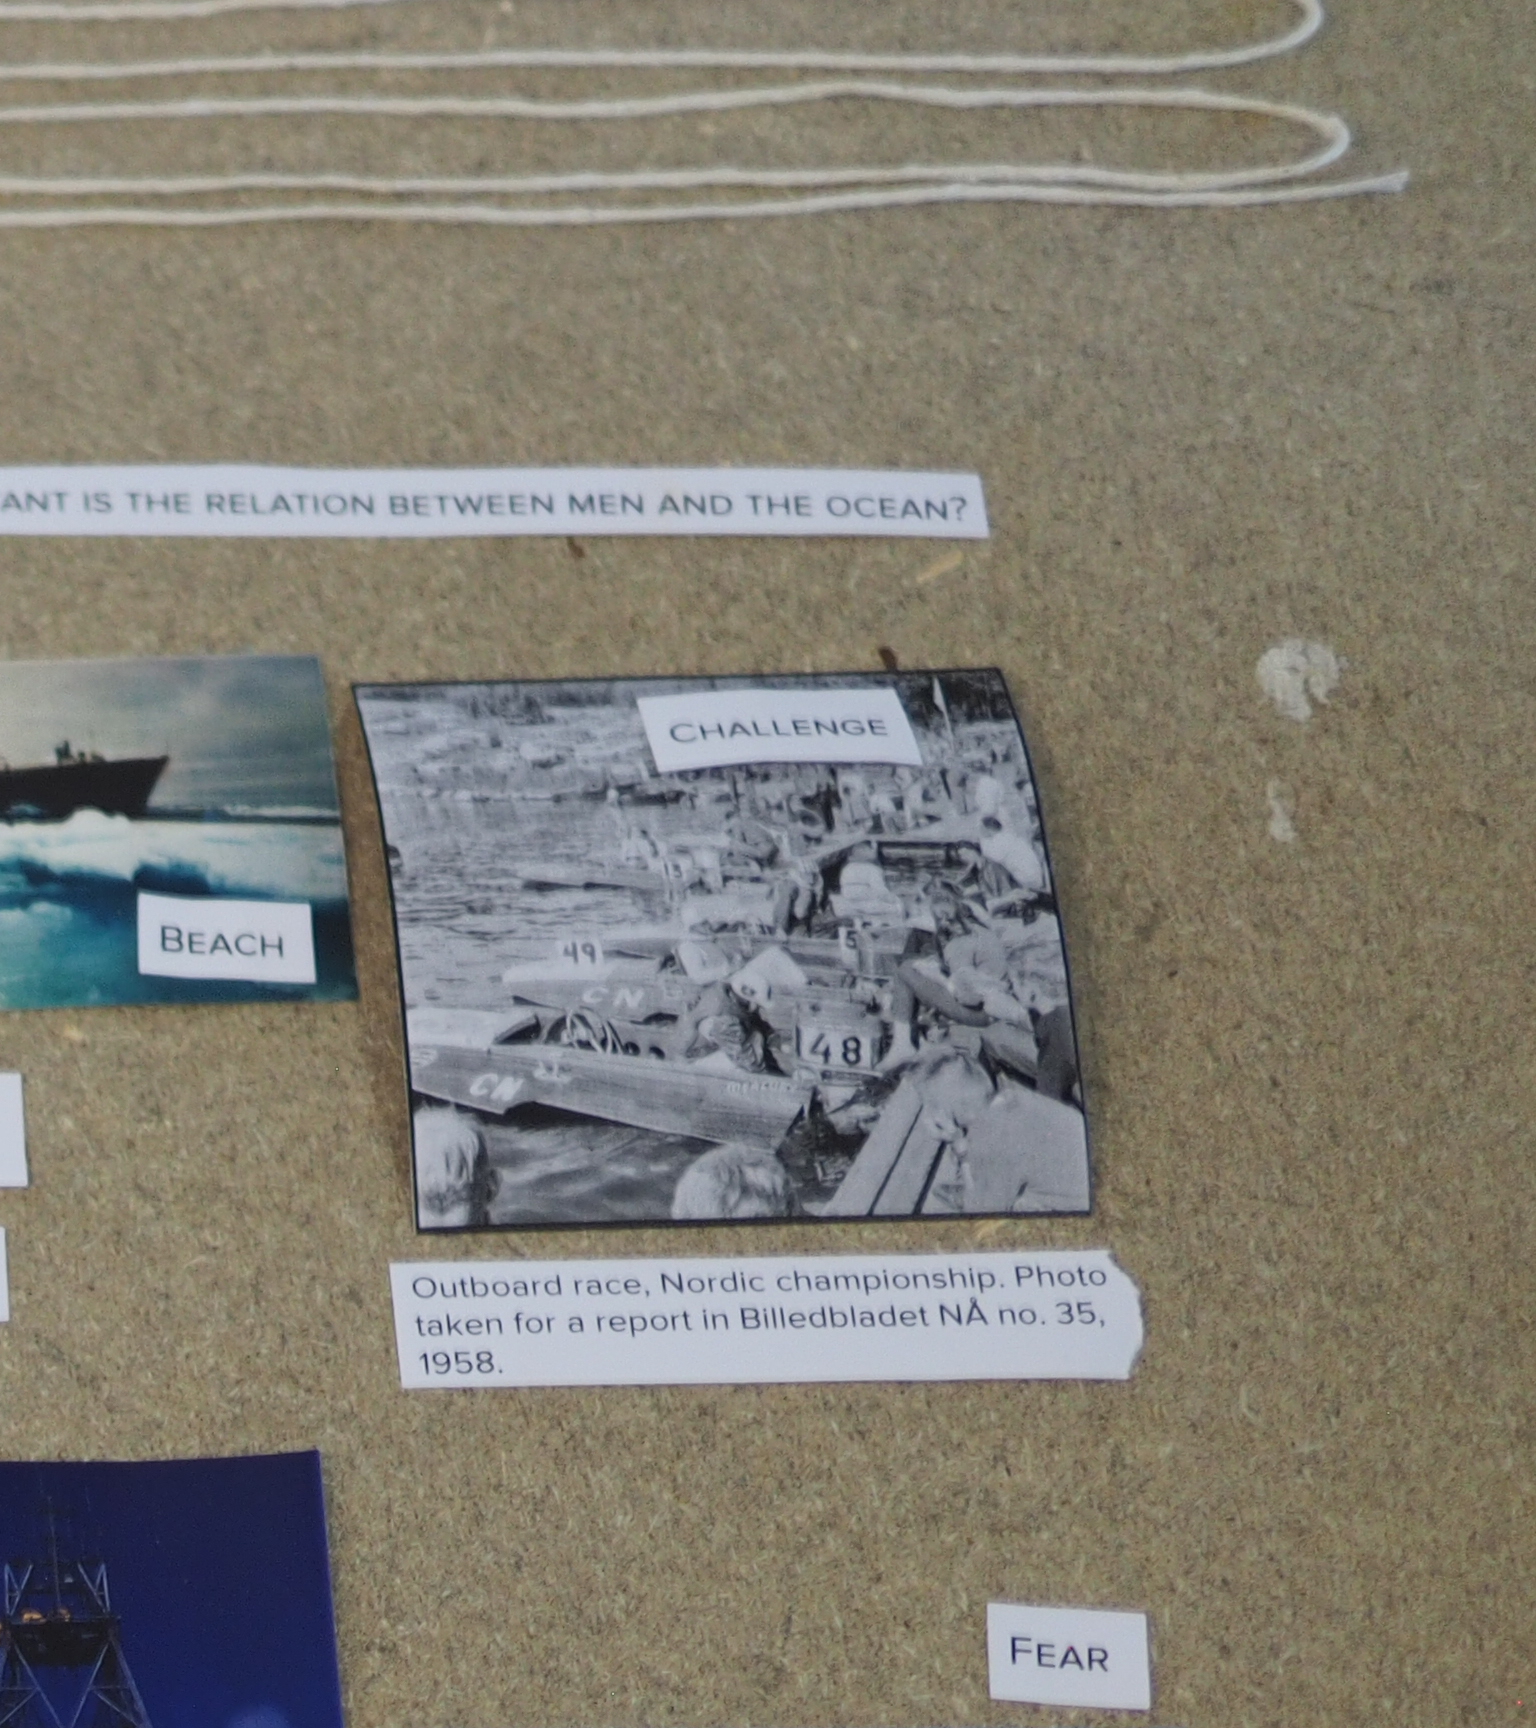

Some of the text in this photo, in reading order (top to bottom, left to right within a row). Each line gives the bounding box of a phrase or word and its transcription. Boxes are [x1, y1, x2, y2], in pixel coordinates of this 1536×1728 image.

[82, 492, 113, 514] IS
[125, 491, 190, 514] THE
[205, 492, 376, 516] RELATION
[388, 493, 555, 517] BETWEEN
[567, 492, 645, 516] MEN
[657, 492, 734, 517] AND
[745, 493, 812, 518] THE
[825, 495, 968, 522] OCEAN?
[668, 718, 888, 744] CHALLENGE
[160, 924, 284, 958] BEACH
[562, 941, 597, 965] 49
[810, 1035, 862, 1065] 48
[411, 1264, 1108, 1300] Outboard race, Nordic championship. Photo
[414, 1298, 1106, 1339] taken for a report in Billedbladet NÅ no. 35,
[419, 1350, 503, 1376] 1958.
[1010, 1635, 1109, 1673] FEAR
